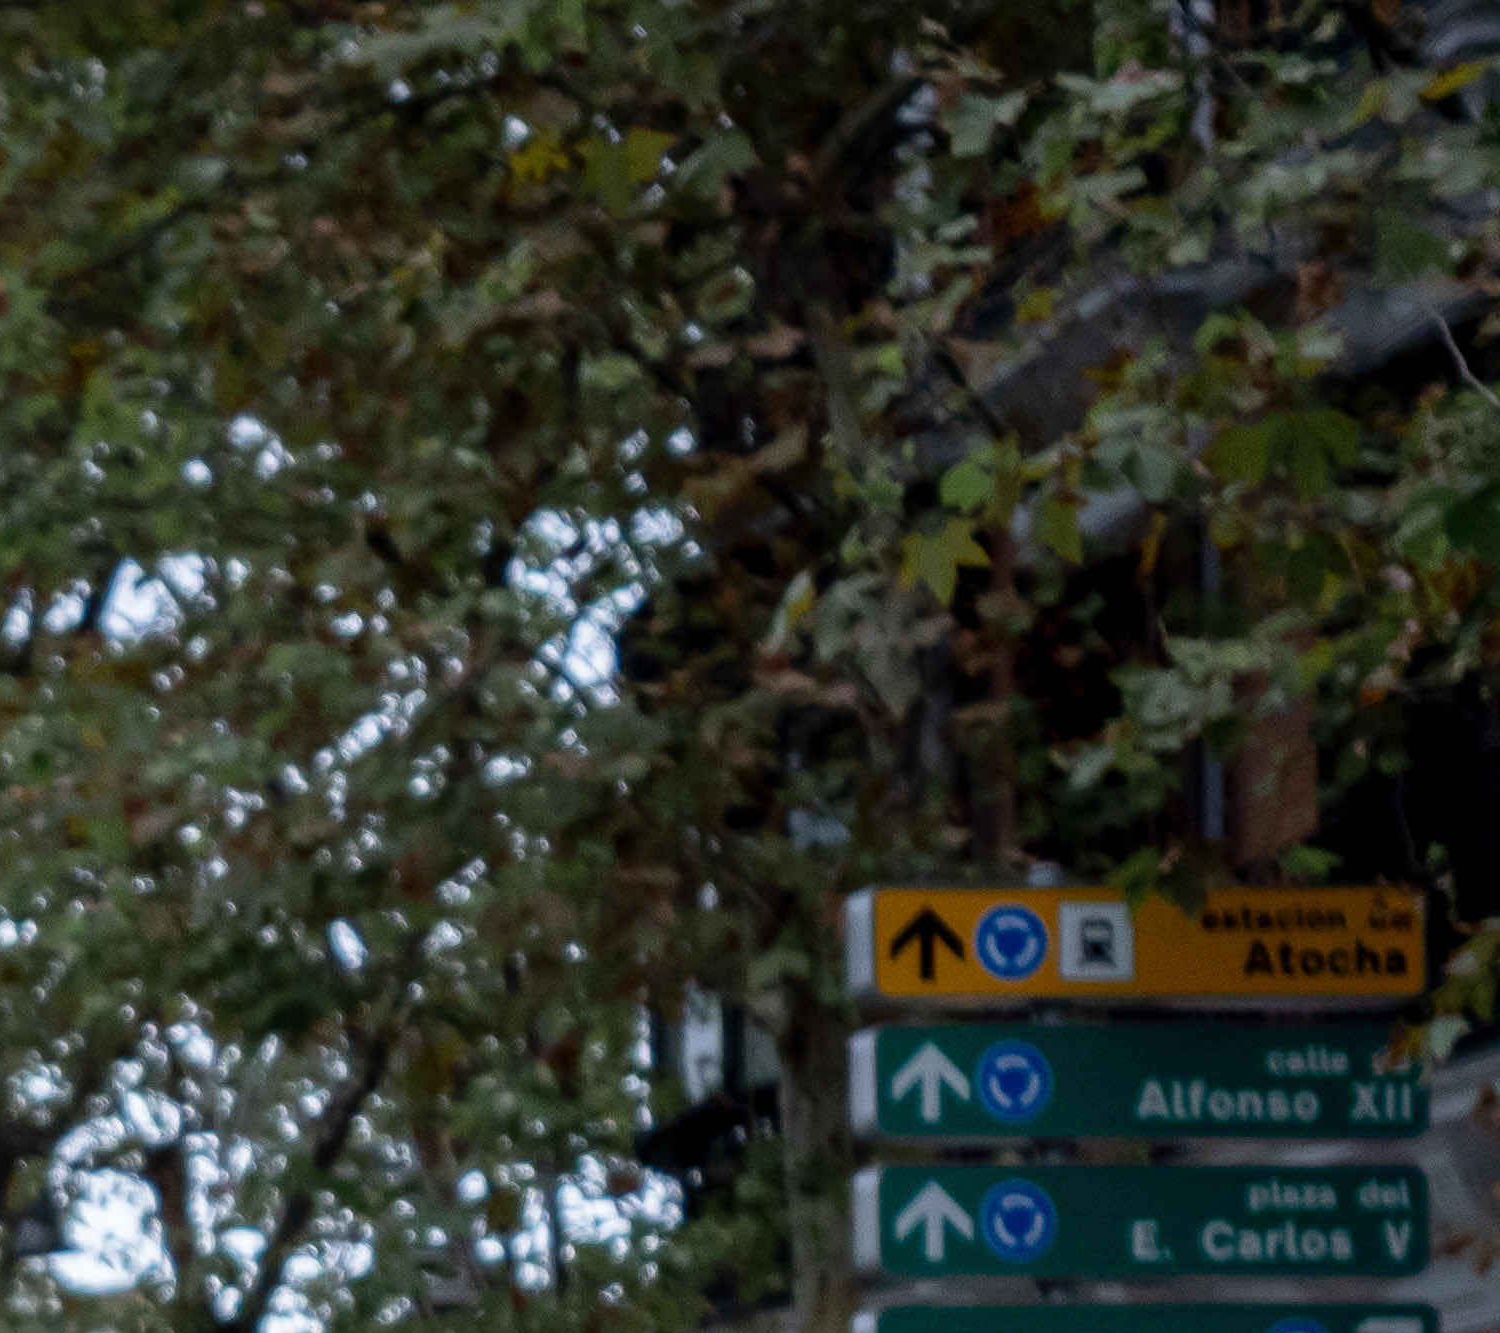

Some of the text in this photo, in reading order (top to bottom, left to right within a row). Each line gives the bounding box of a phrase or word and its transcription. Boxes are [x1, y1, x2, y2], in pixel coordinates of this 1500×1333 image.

[1244, 939, 1407, 977] Atocha
[1266, 1044, 1349, 1074] calle
[1137, 1079, 1413, 1121] Alfonso XII
[1248, 1177, 1411, 1211] plaza del
[1131, 1218, 1412, 1262] E. Carlos V
